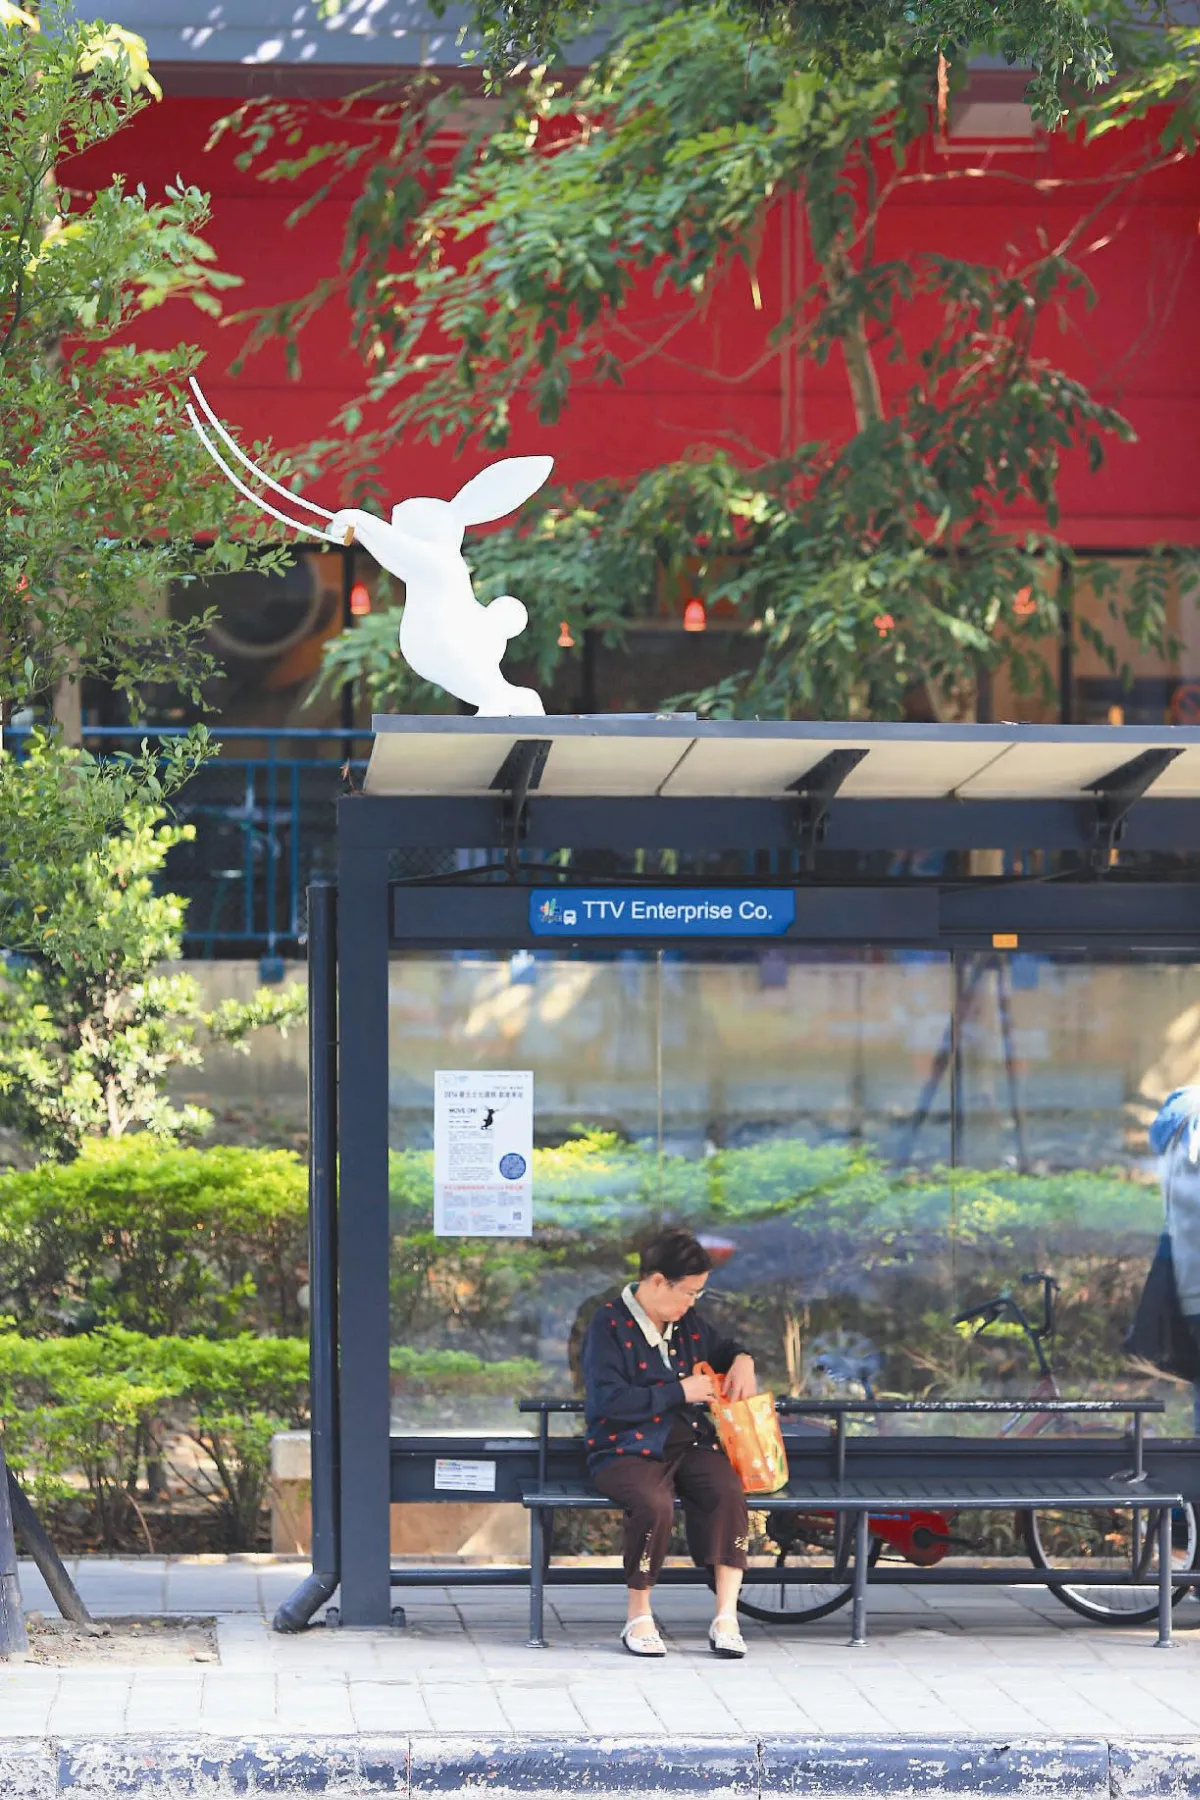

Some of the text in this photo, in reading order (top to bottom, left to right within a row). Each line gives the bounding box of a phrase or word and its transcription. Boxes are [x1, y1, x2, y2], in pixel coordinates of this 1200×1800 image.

[582, 900, 625, 919] TTV
[631, 900, 733, 923] Enterprise
[738, 900, 772, 919] Co.
